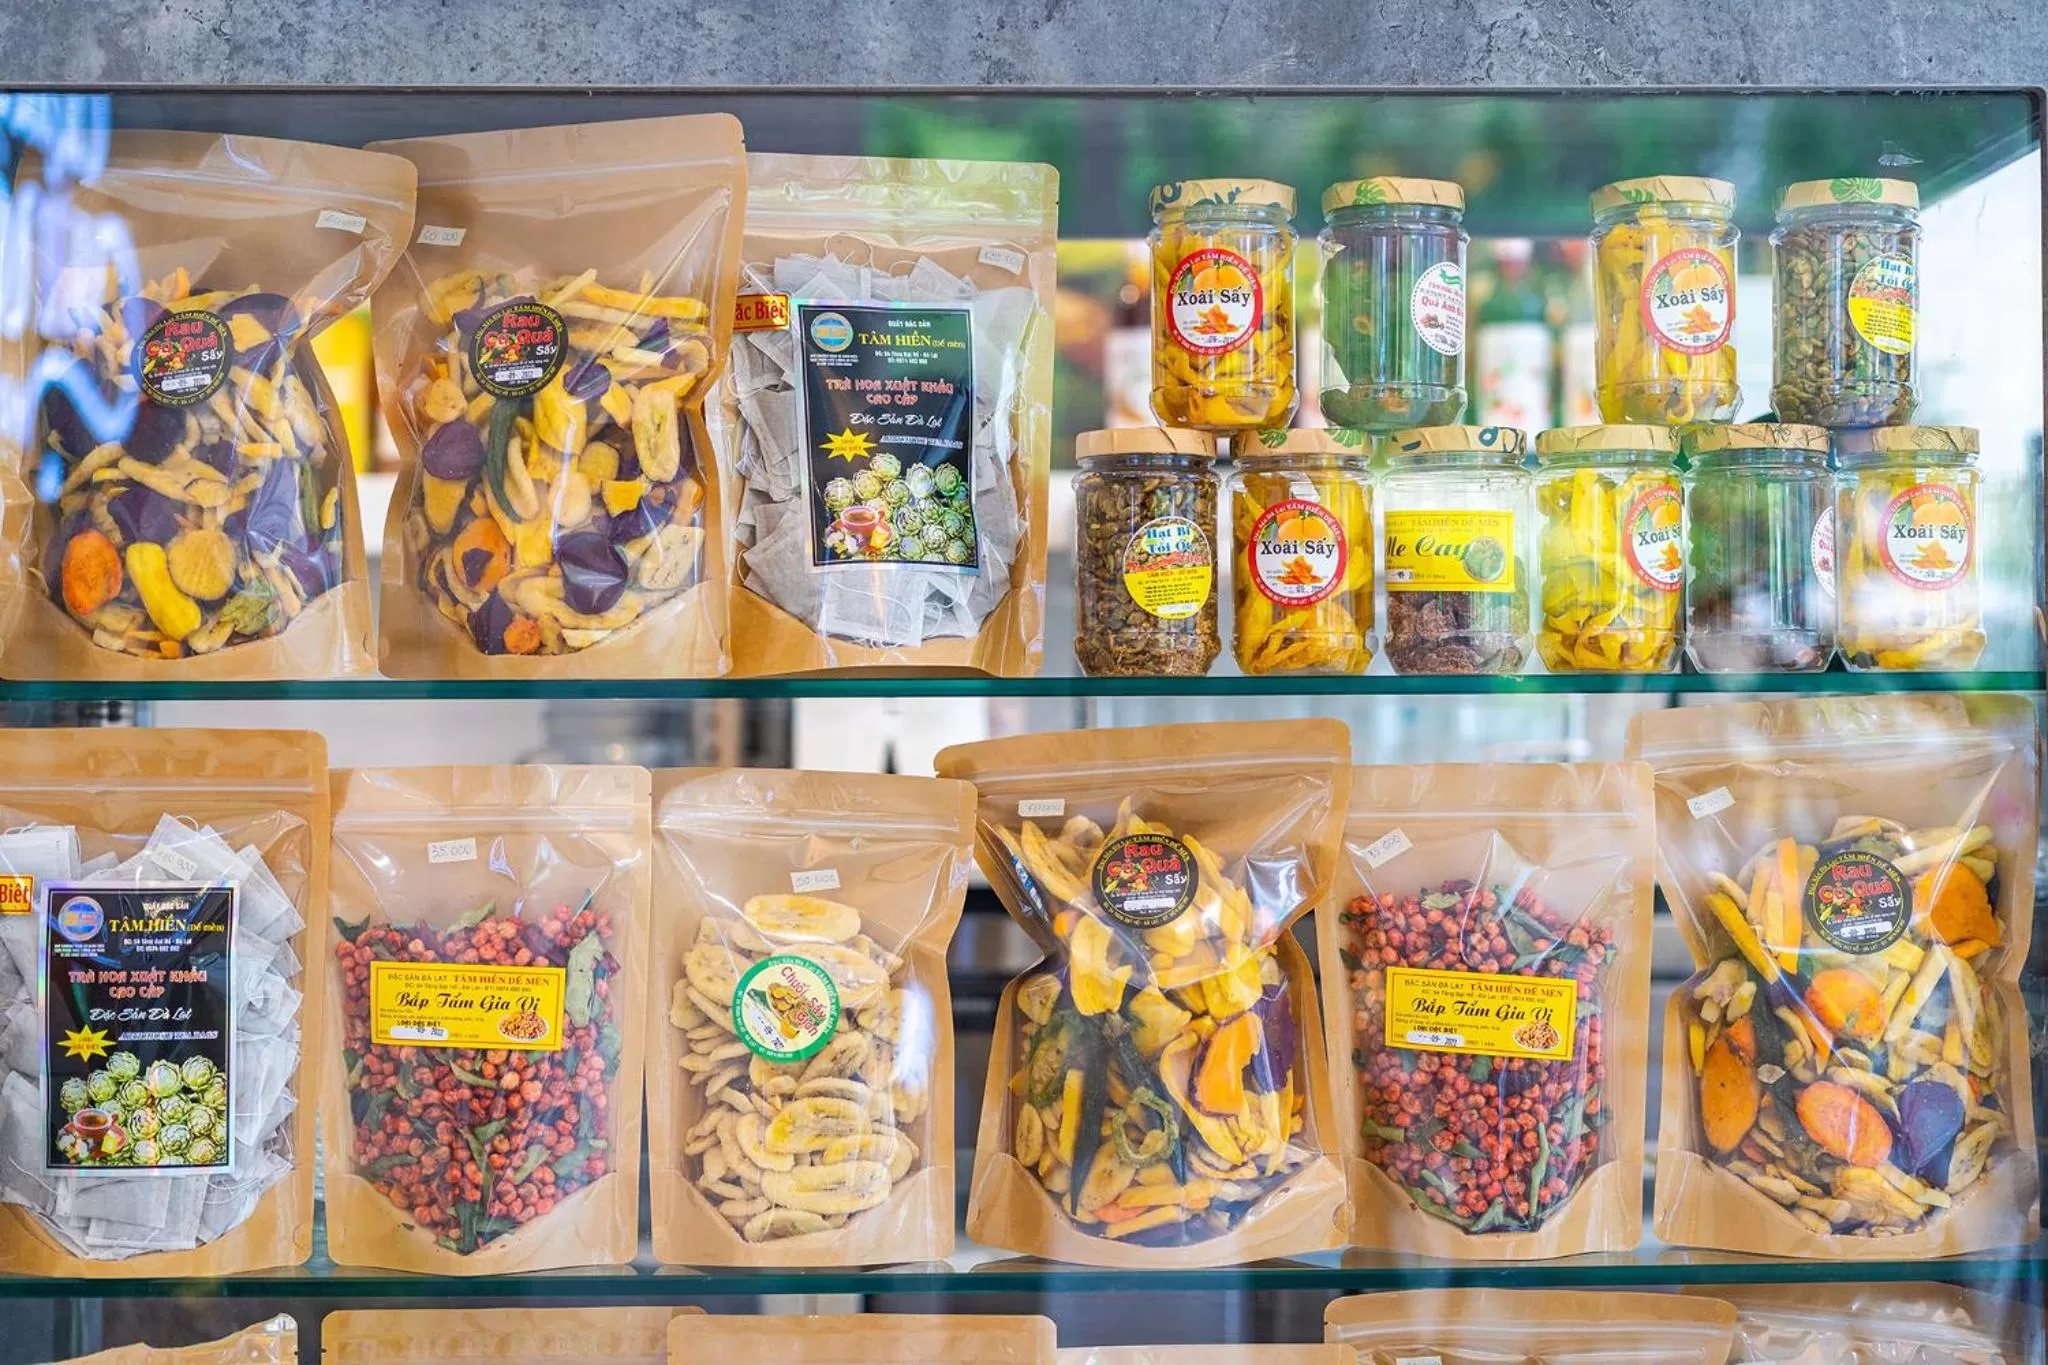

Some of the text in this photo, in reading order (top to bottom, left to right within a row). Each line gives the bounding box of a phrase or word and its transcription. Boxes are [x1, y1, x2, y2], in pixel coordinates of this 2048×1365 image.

[1177, 286, 1251, 307] Xoài Sấy
[1656, 283, 1725, 309] Xoài Sấy
[165, 320, 203, 338] Rau
[502, 312, 541, 329] Rau
[180, 331, 218, 352] Quả
[517, 325, 554, 345] Quả
[858, 329, 891, 345] TÂM
[855, 378, 881, 391] HOA
[1638, 527, 1669, 546] Xoài
[1893, 522, 1966, 544] Xoài Sấy
[1261, 537, 1336, 559] Xoài Sấy
[1124, 843, 1163, 858] Rau
[1141, 854, 1181, 874] Quả
[1832, 863, 1872, 881] Rau
[1852, 875, 1893, 897] Quả
[1878, 894, 1901, 909] Sấy
[109, 915, 144, 932] TÂM
[68, 969, 95, 983] TRÀ
[98, 970, 127, 983] HOA
[109, 986, 135, 999] CAO
[395, 990, 429, 1011] Bắp
[437, 992, 473, 1009] Tẩm
[479, 993, 509, 1012] Gia
[1411, 997, 1446, 1016] Bắp
[1453, 1000, 1489, 1018] Tẩm
[1495, 1003, 1525, 1022] Gia
[1531, 1007, 1554, 1024] Vị
